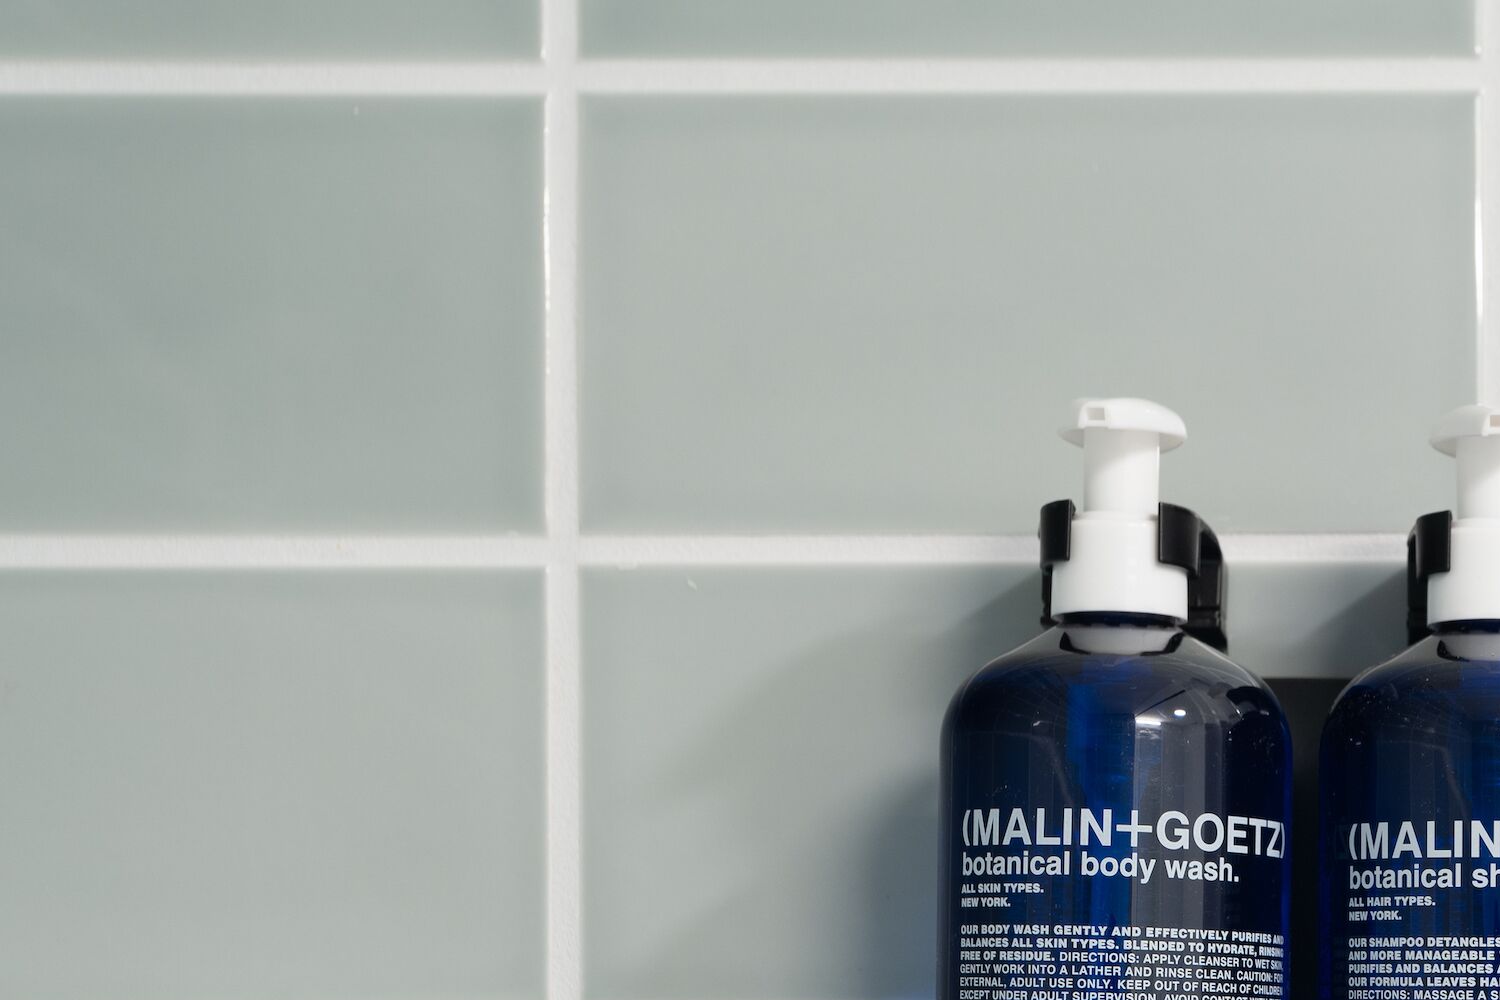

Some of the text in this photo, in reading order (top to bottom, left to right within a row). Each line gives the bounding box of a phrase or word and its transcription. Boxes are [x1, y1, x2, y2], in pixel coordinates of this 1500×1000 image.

[962, 808, 1285, 859] (MALIN+GOETZ)
[962, 850, 1239, 884] botanical body wash.
[1349, 863, 1462, 890] botanical
[961, 883, 1044, 894] ALL SKIN TYPES.
[961, 897, 1010, 908] NEW YORK.
[1348, 896, 1436, 907] ALL HAIR TYPES.
[1348, 910, 1402, 922] NEW YORK.
[960, 924, 1272, 944] OUR BODY WASH GENTLY AND EFFECTIVELY PURIFIES
[960, 937, 1257, 957] BALANCES ALL SKIN TYPES. BLENDED TO HYDRATE,
[1348, 937, 1367, 948] OUR
[1368, 937, 1424, 948] SHAMPOO
[960, 951, 1270, 970] FREE OF RESIDUE. DIRECTIONS: APPLY CLEANSER TO WET
[1348, 950, 1367, 961] AND
[1370, 951, 1401, 961] MORE
[1404, 951, 1495, 961] MANAGEABLE
[1348, 963, 1393, 974] PURIFIES
[1395, 964, 1420, 974] AND
[1423, 964, 1494, 974] BALANCES
[959, 977, 1251, 994] EXTERNAL, ADULT USE ONLY. KEEP OUT OF REACH OF
